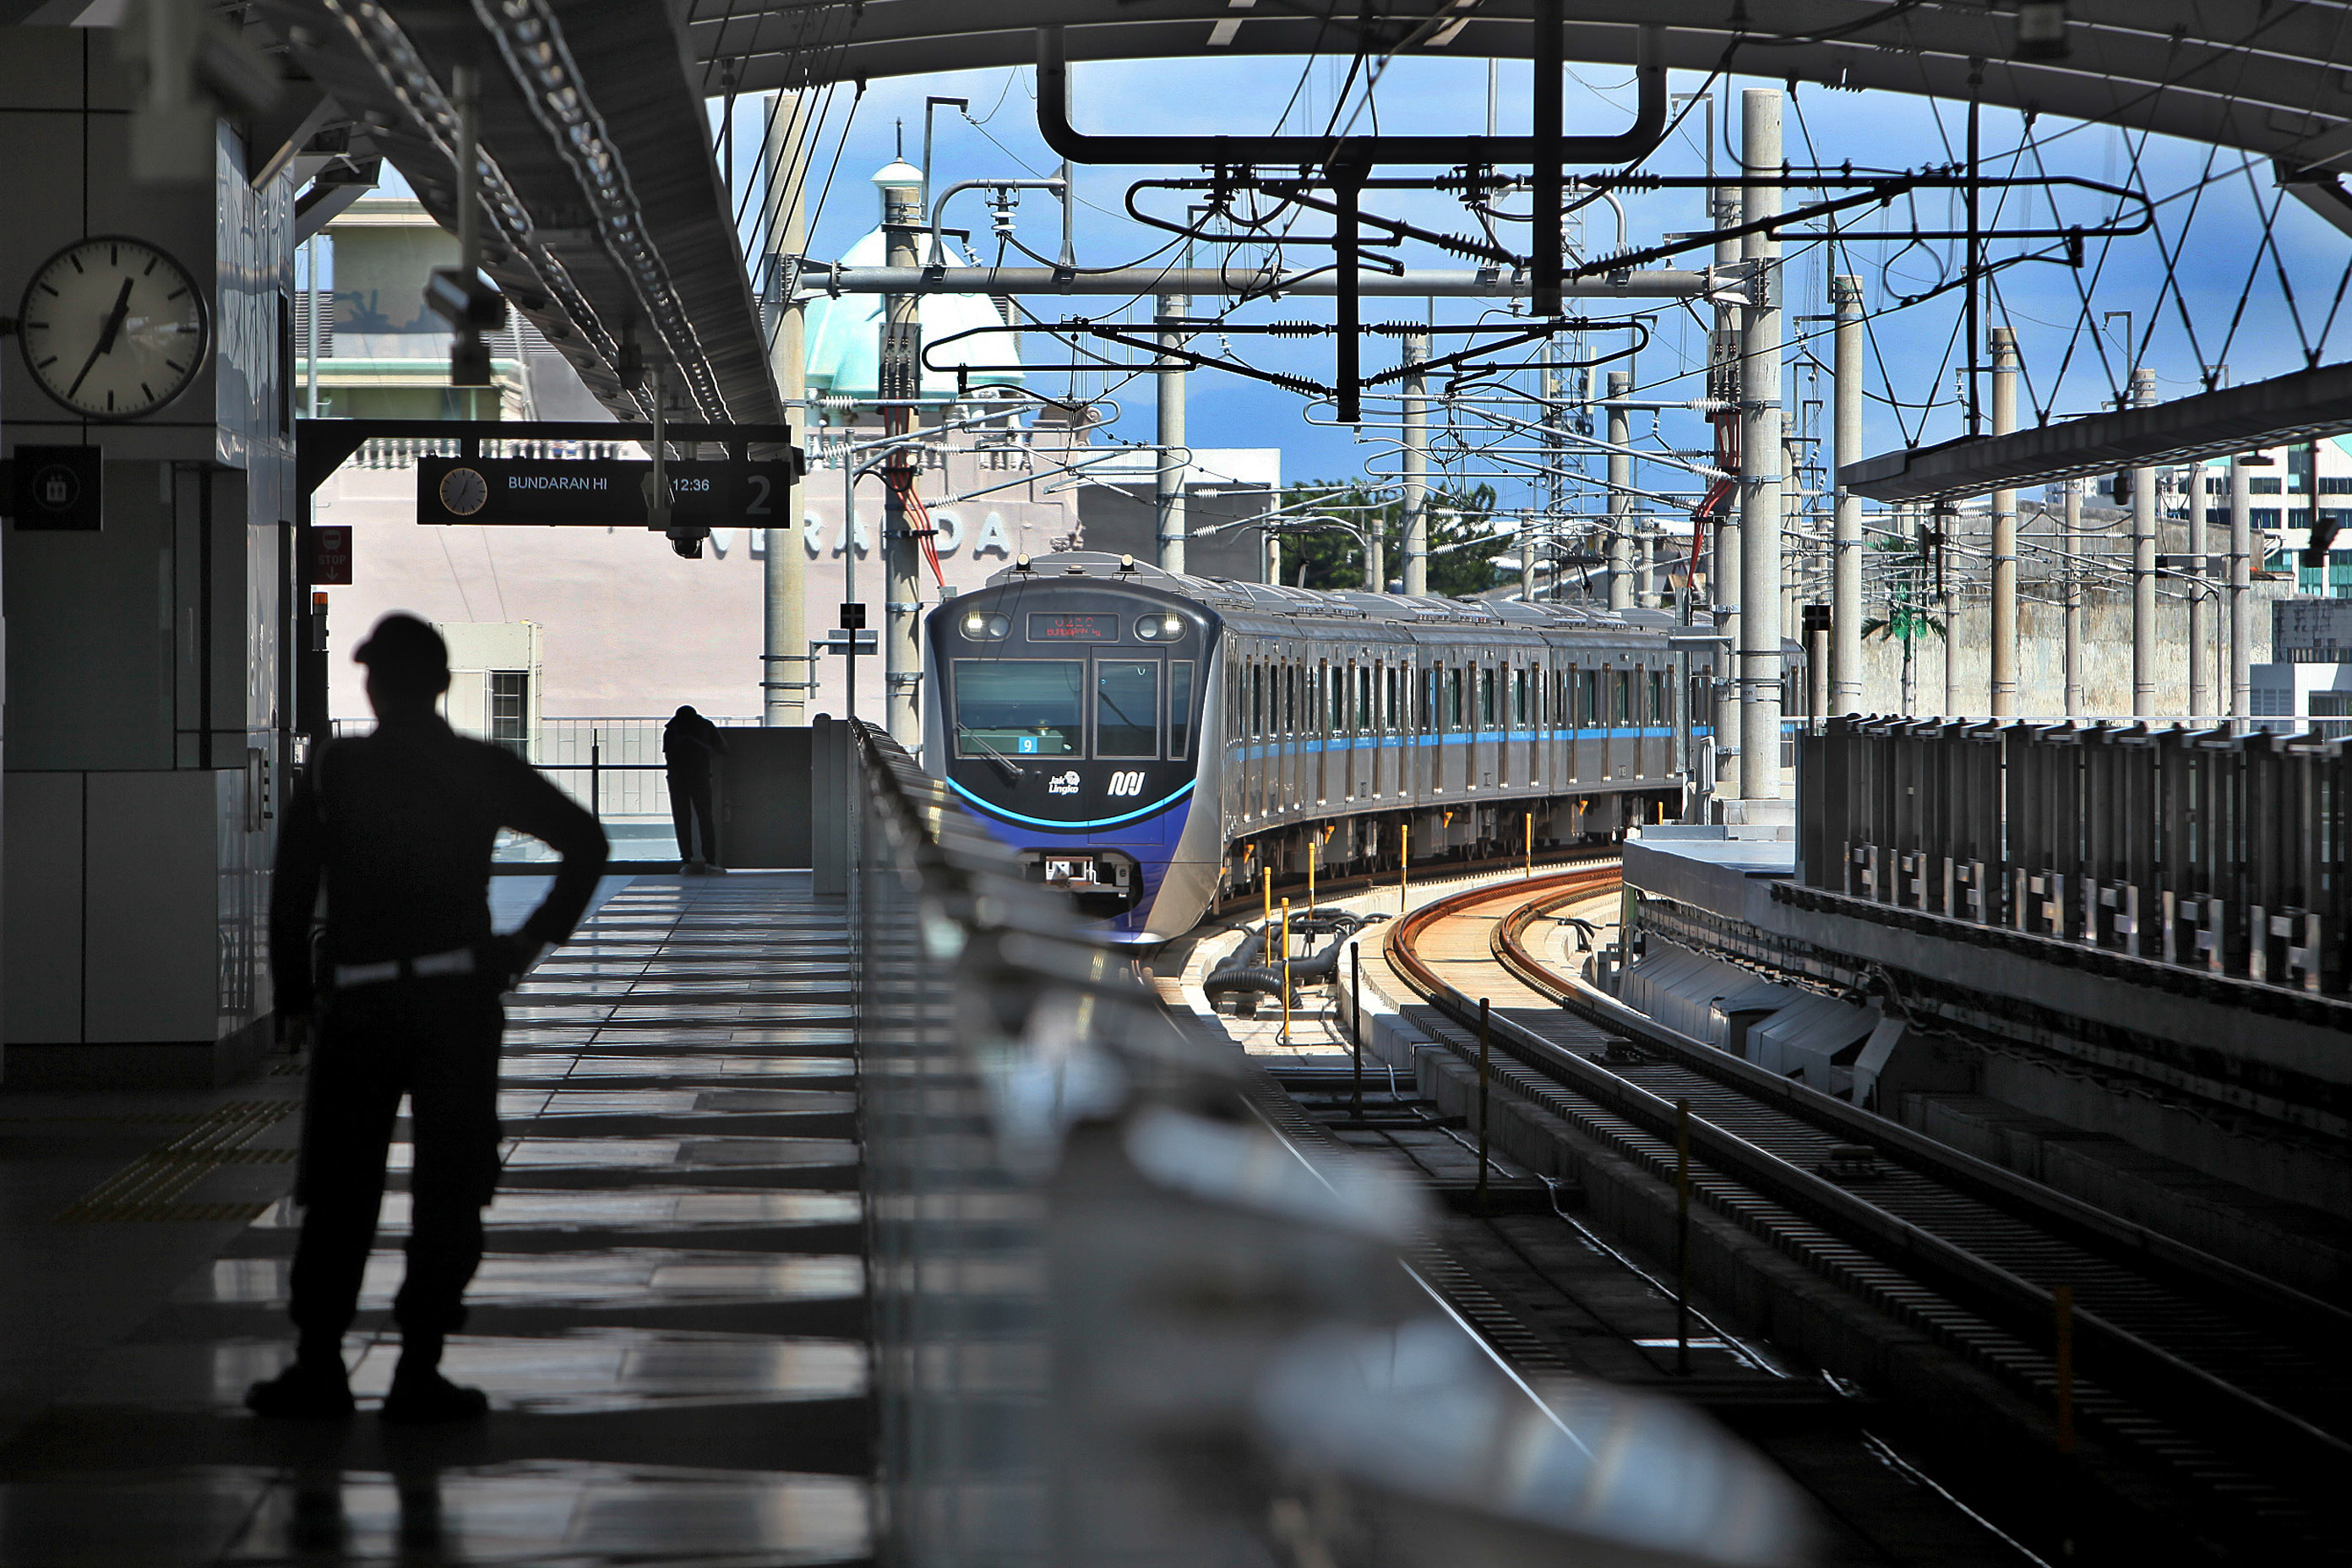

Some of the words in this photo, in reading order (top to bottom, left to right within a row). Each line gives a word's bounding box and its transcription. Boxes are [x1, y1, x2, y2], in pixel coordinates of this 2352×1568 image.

[509, 476, 589, 490] BUNDARAN
[593, 476, 607, 490] HI
[673, 478, 710, 491] 12:36
[746, 474, 771, 514] 2
[318, 554, 346, 565] STOP
[1024, 739, 1032, 753] 9
[1048, 776, 1065, 785] Jak
[1048, 785, 1079, 795] Lingko
